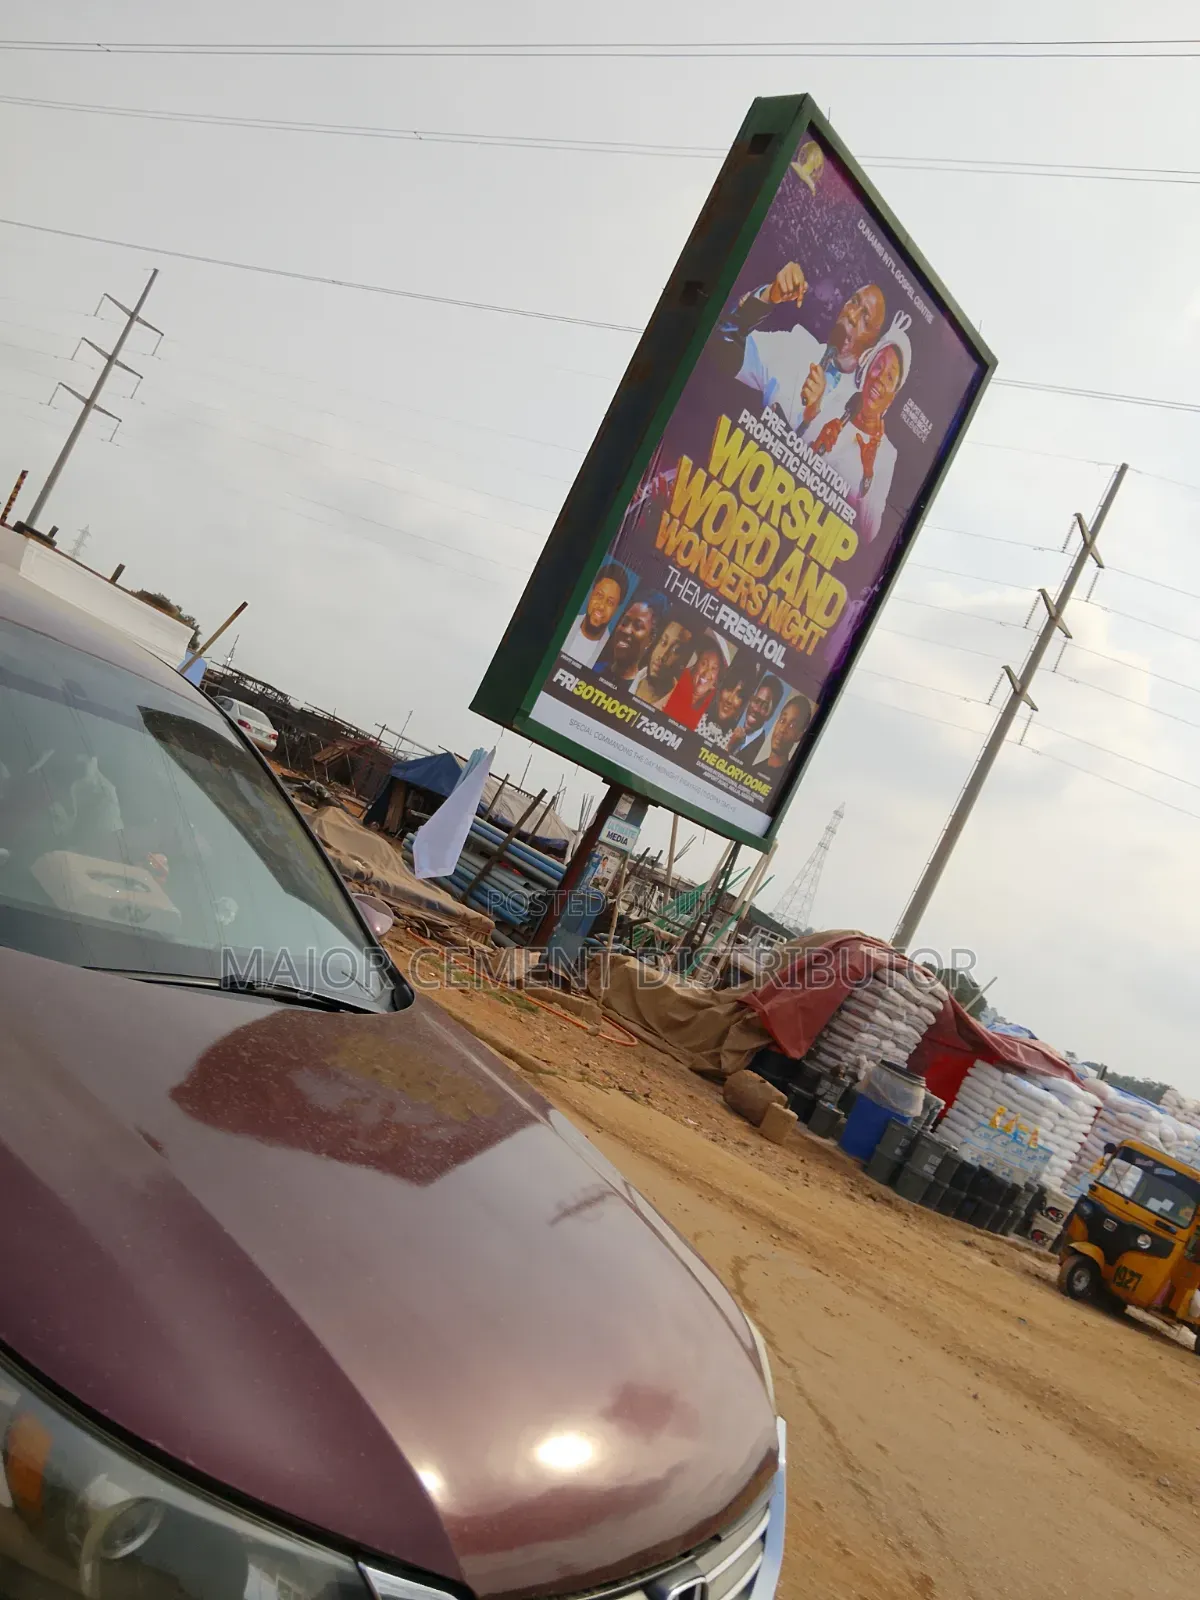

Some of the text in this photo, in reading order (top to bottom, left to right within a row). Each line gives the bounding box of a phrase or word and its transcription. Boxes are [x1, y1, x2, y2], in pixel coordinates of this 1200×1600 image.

[893, 267, 916, 301] GOSPEL
[912, 293, 935, 326] CENTRE
[738, 408, 858, 525] PROPHETIC ENCOUNTER
[760, 405, 850, 499] PRE-CONVENTION
[708, 414, 859, 571] WORSHIP
[670, 454, 848, 629] WORD AND
[655, 510, 828, 656] WONDERS NIGHT
[714, 604, 768, 653] FRESH
[763, 640, 787, 669] OIL
[567, 716, 595, 737] SPECIAL
[636, 713, 684, 751] 7:30PM
[698, 746, 719, 766] THE
[715, 758, 748, 783] GLORY
[743, 774, 773, 797] DOME
[606, 830, 629, 846] MEDIA
